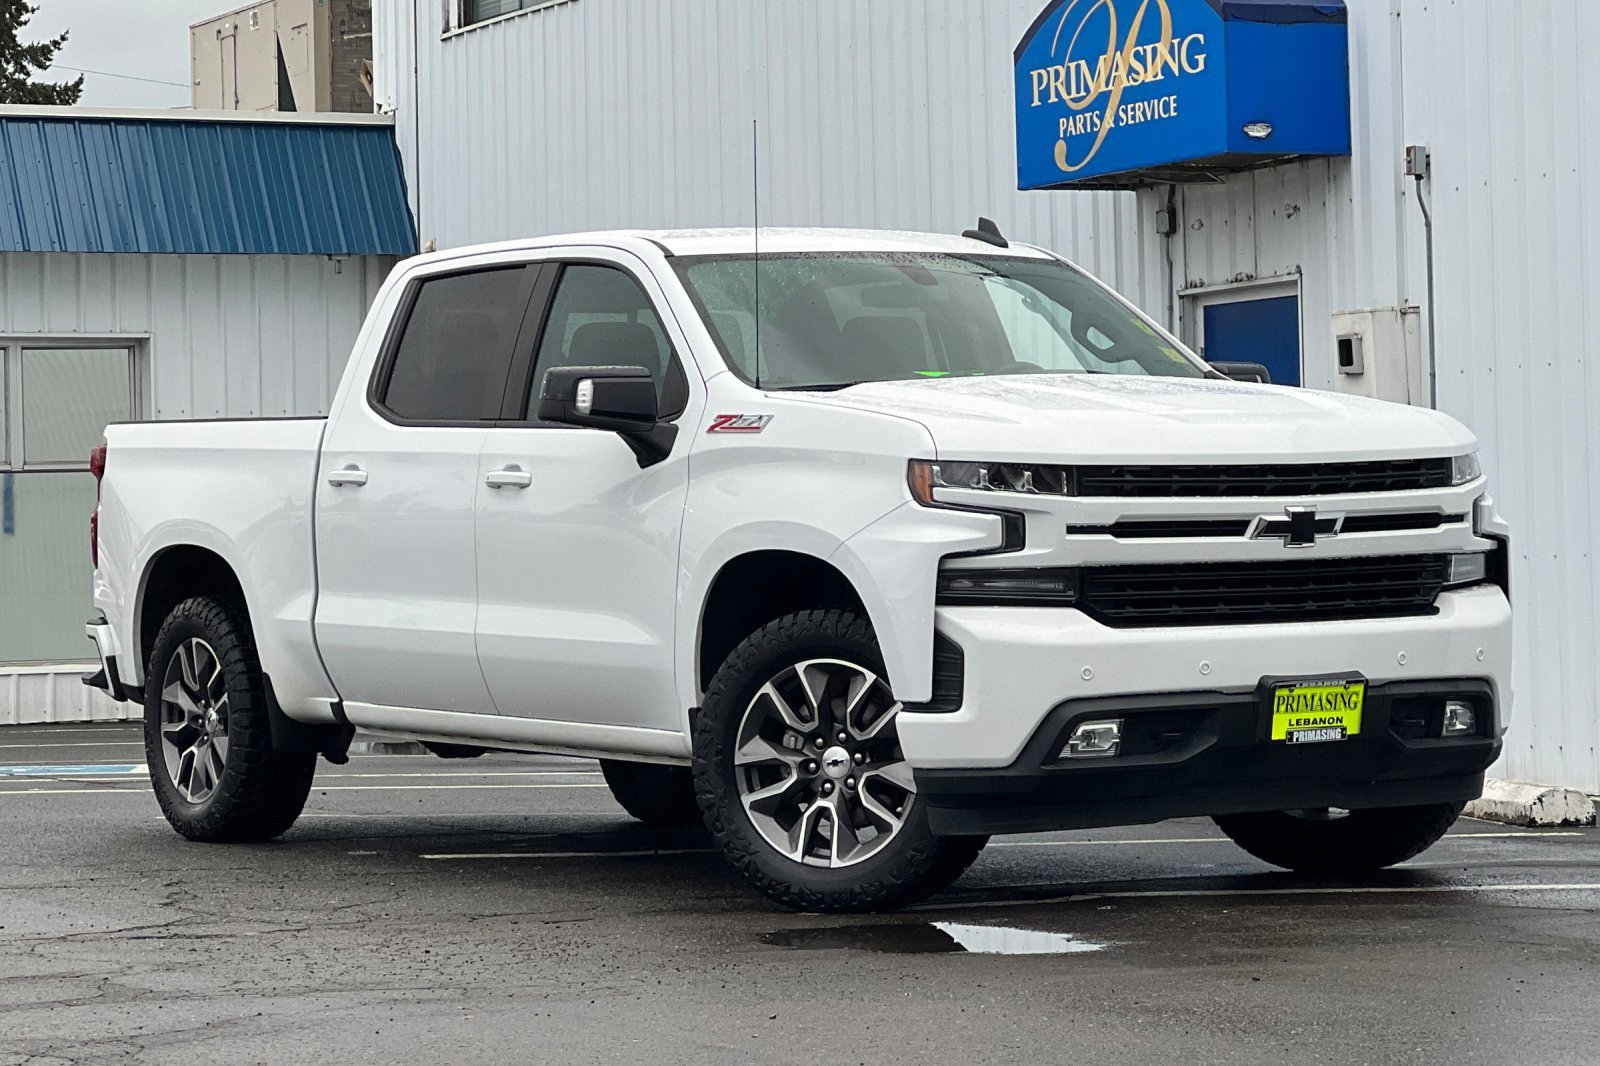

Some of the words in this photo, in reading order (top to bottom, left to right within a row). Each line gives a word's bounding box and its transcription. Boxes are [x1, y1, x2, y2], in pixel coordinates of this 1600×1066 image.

[1030, 33, 1207, 107] PRIMASING
[1059, 110, 1101, 138] PARTS
[1104, 108, 1115, 129] &
[1118, 95, 1178, 127] SERVICE
[1295, 680, 1347, 688] LEBANON
[1276, 690, 1360, 713] PRIMASING
[1288, 716, 1344, 727] LEBANON
[1292, 728, 1342, 742] PRIMASING
